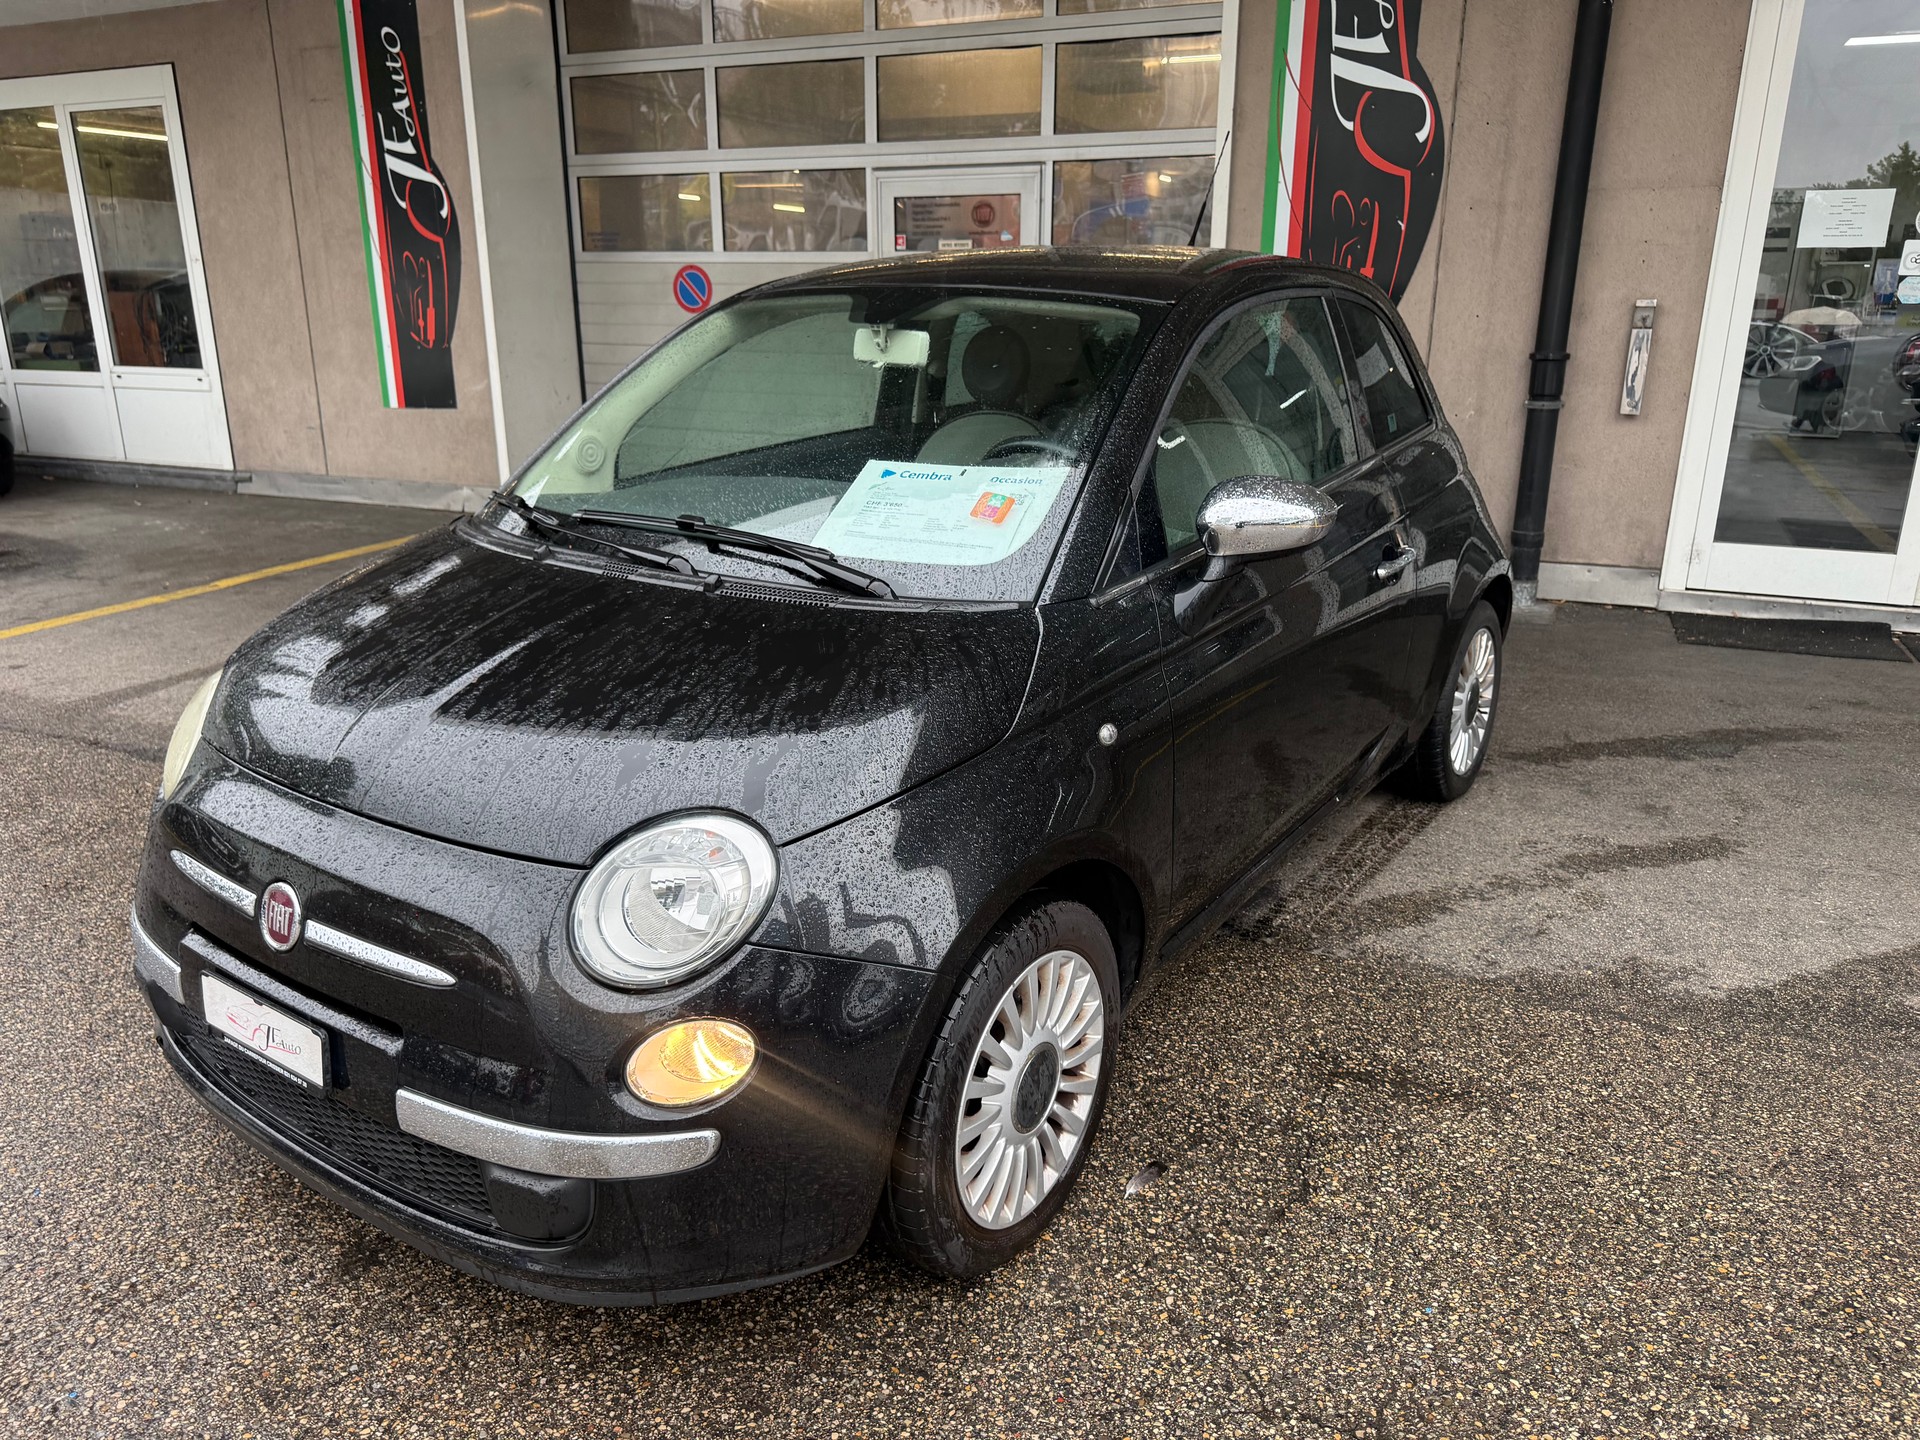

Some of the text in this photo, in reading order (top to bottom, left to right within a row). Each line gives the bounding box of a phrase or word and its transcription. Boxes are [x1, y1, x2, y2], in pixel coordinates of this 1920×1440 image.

[900, 470, 952, 481] Cembra
[989, 476, 1043, 485] Occasion
[268, 898, 293, 936] FIAT
